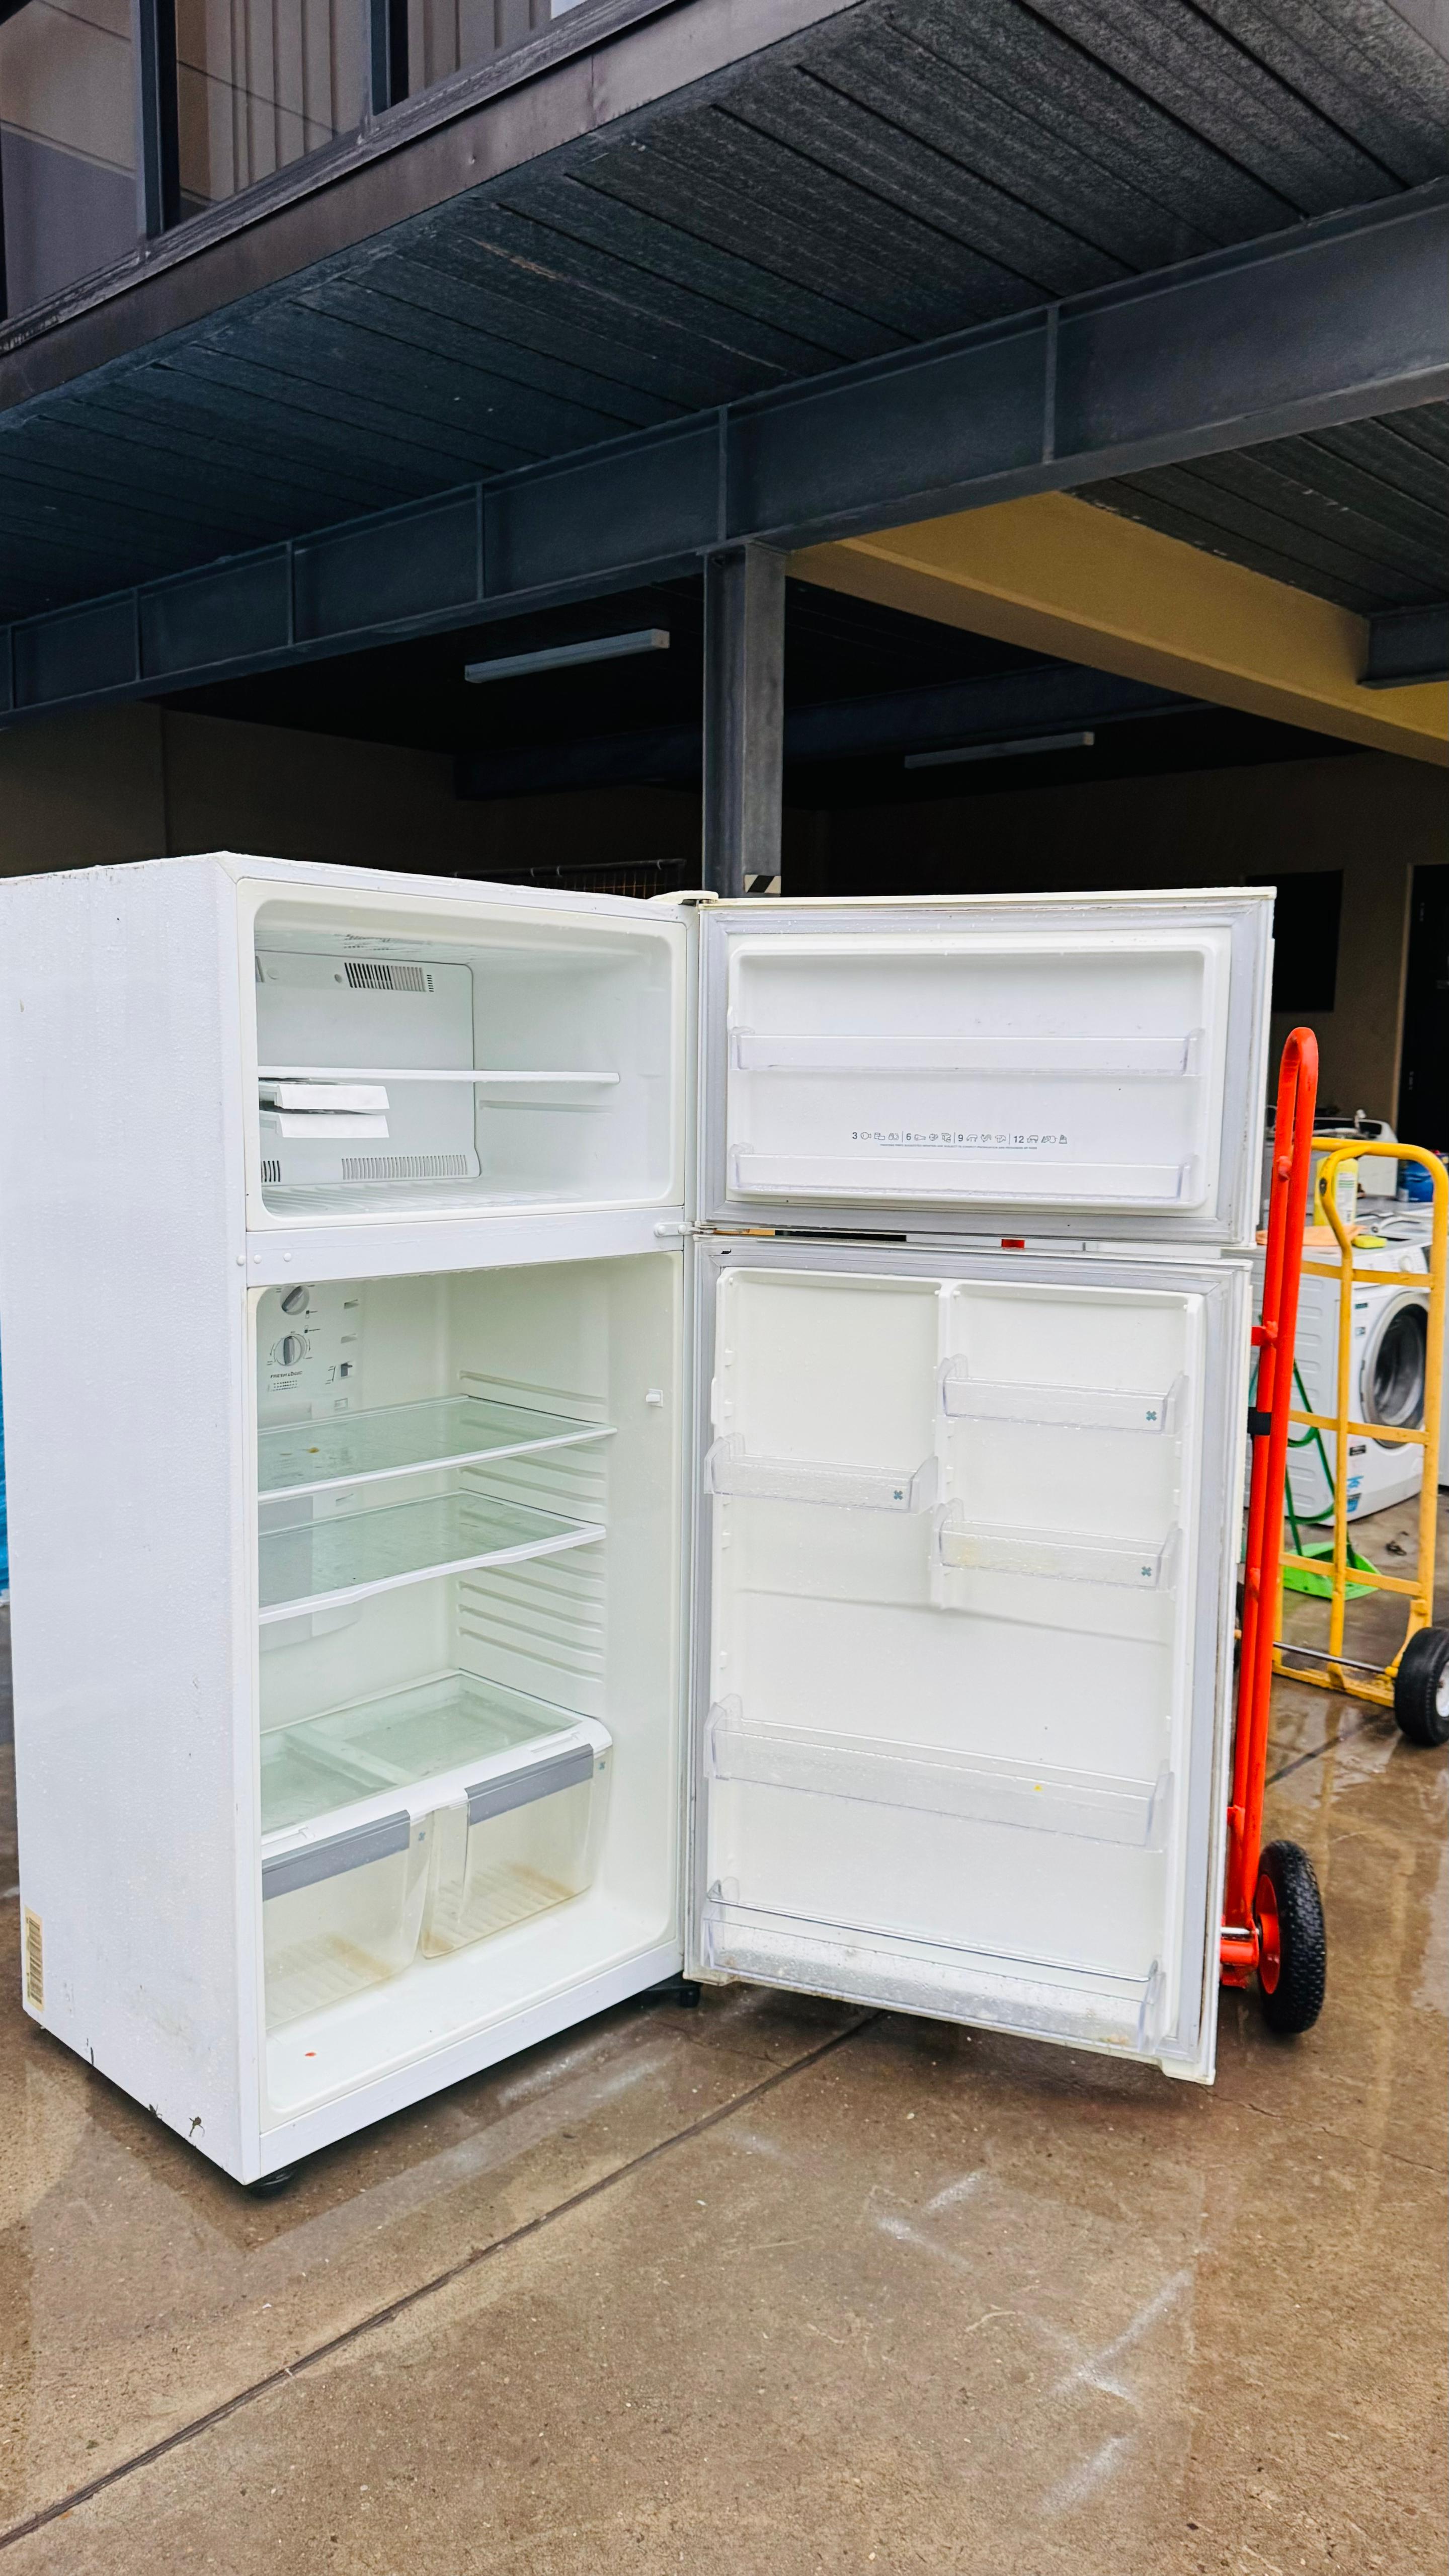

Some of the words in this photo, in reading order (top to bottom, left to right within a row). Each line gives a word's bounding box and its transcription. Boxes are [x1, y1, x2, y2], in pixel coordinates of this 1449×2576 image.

[852, 1132, 858, 1140] 3
[958, 1134, 963, 1142] 9
[1013, 1136, 1024, 1144] 12
